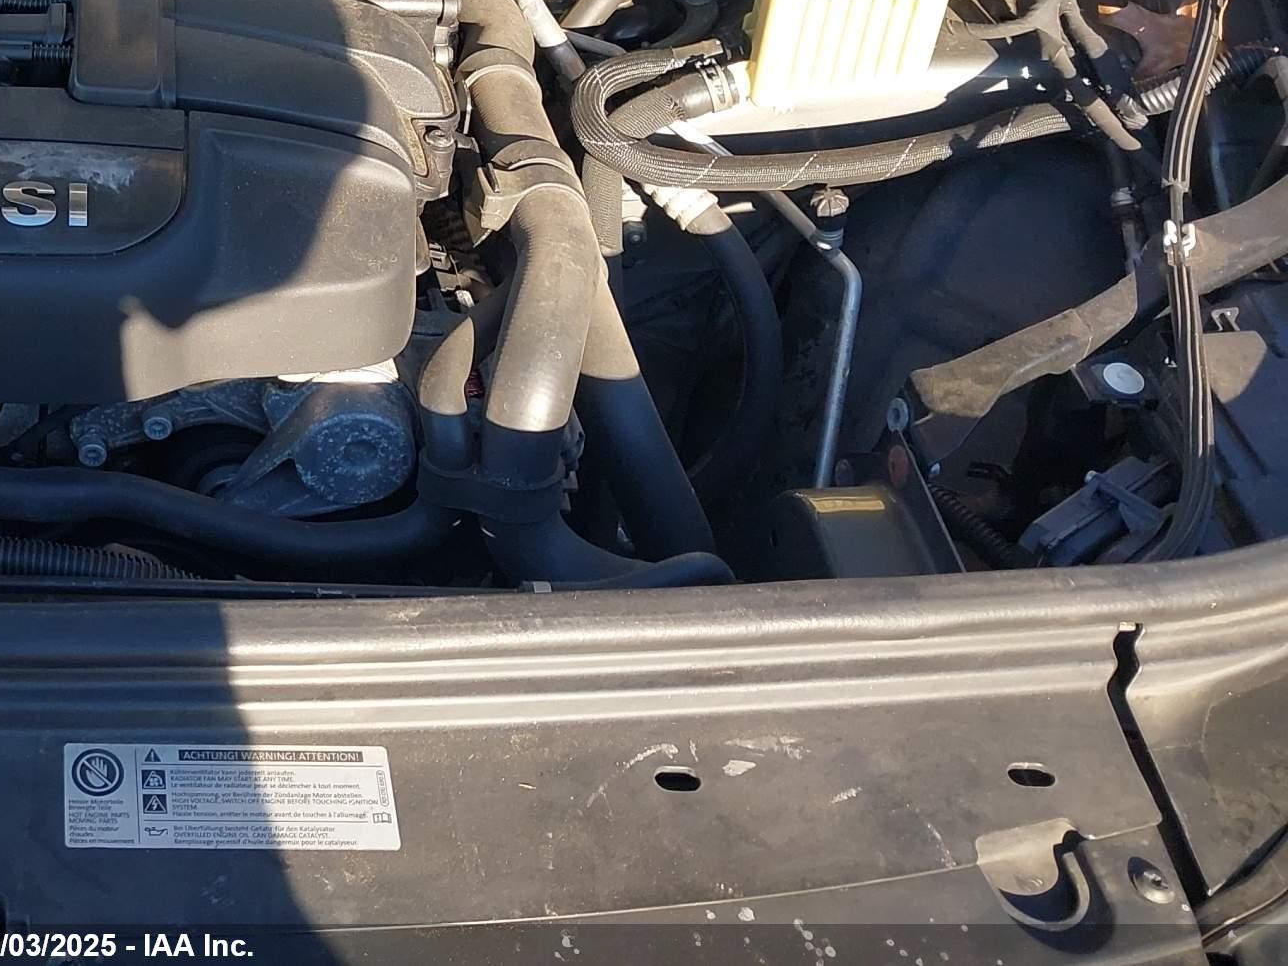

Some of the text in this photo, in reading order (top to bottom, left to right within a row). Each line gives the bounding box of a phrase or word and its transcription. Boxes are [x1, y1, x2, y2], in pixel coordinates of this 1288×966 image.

[183, 751, 360, 761] ACHTUNG! WARNING! ATTENTION!
